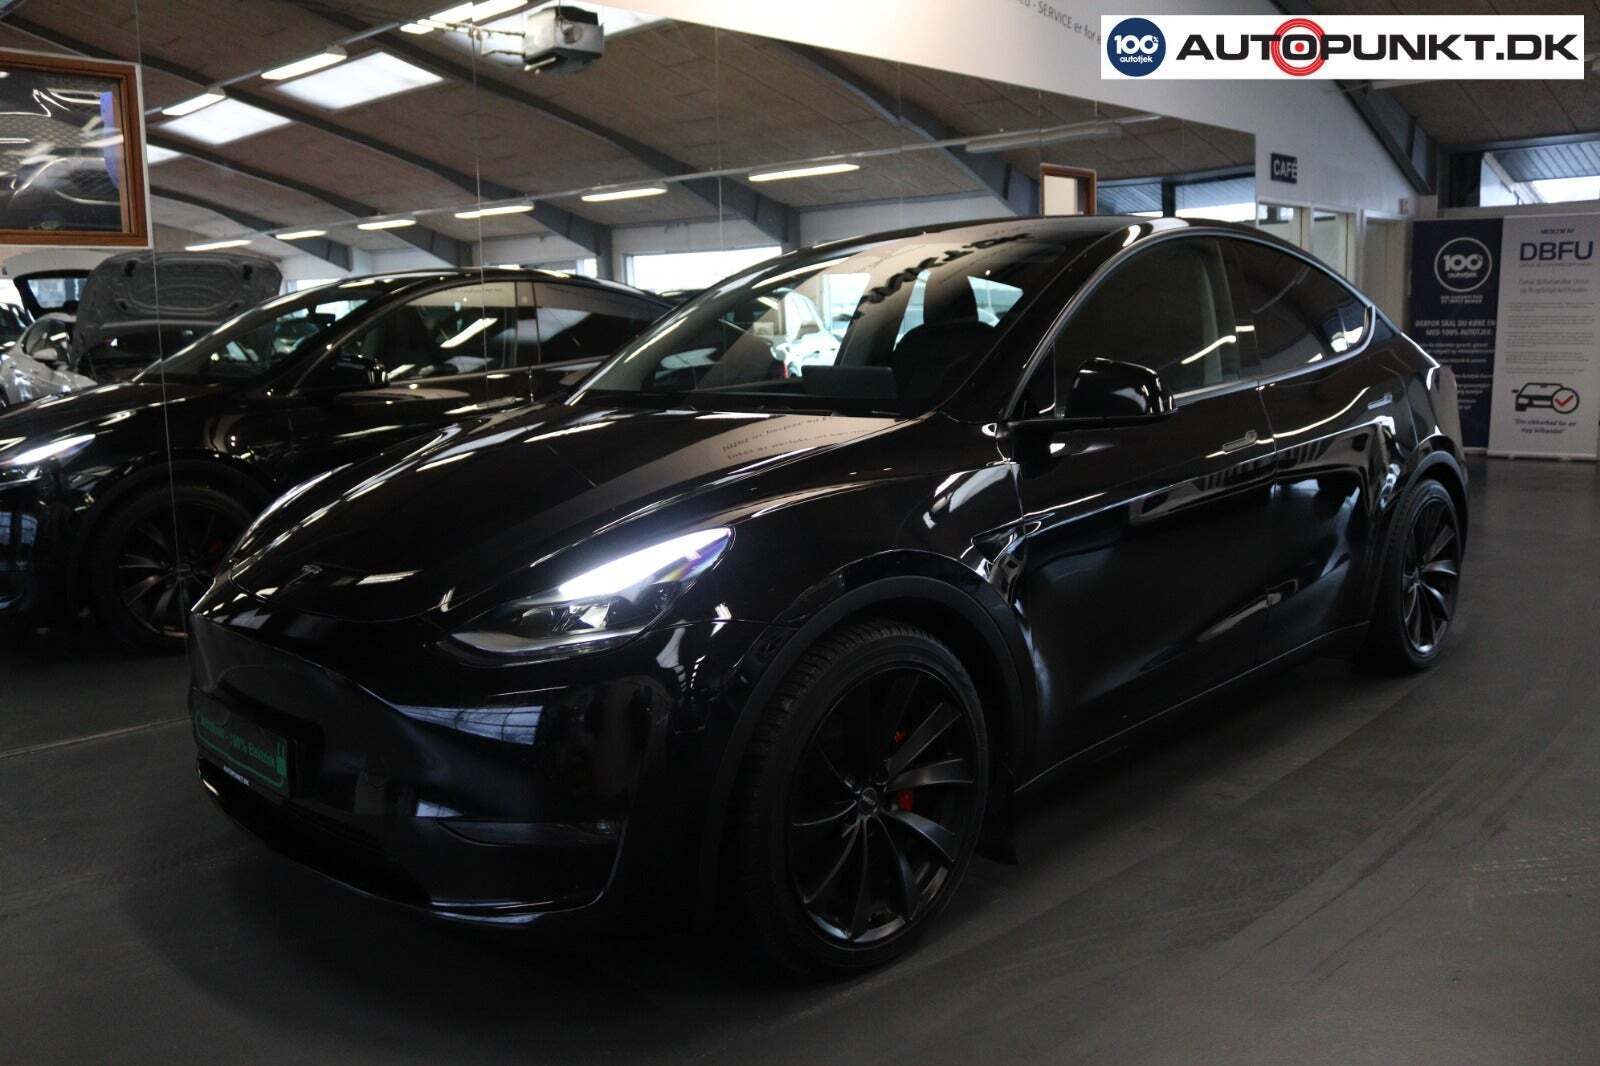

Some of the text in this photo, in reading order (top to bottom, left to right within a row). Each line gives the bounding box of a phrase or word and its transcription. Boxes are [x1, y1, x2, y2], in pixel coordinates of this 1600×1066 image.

[1038, 0, 1072, 29] SERVICE
[1074, 22, 1082, 33] er
[1084, 24, 1095, 40] for
[1519, 240, 1594, 261] DBFU
